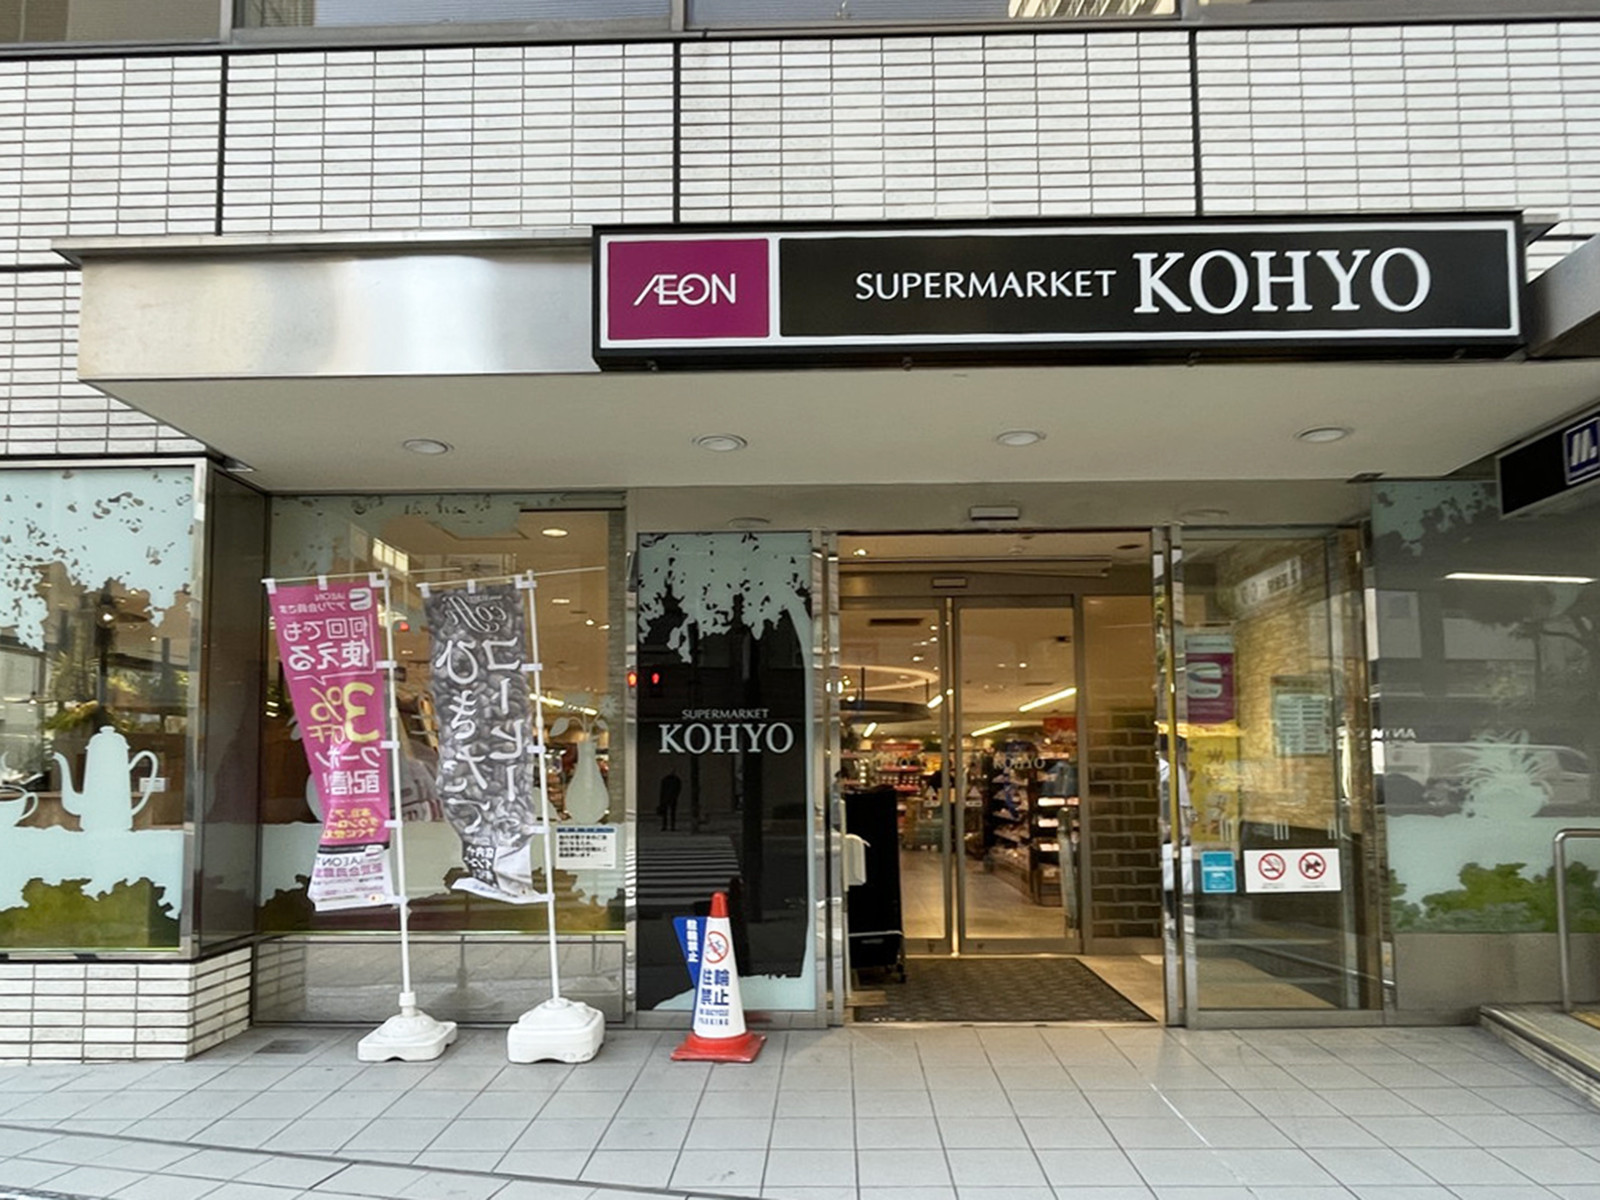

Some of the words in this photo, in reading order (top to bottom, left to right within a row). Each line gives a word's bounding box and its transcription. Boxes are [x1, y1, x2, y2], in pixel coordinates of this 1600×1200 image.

[854, 268, 1117, 302] SUPERMARKET
[1132, 246, 1432, 316] KOHYO
[681, 708, 769, 720] SUPERMARKET
[658, 722, 795, 754] KOHYO
